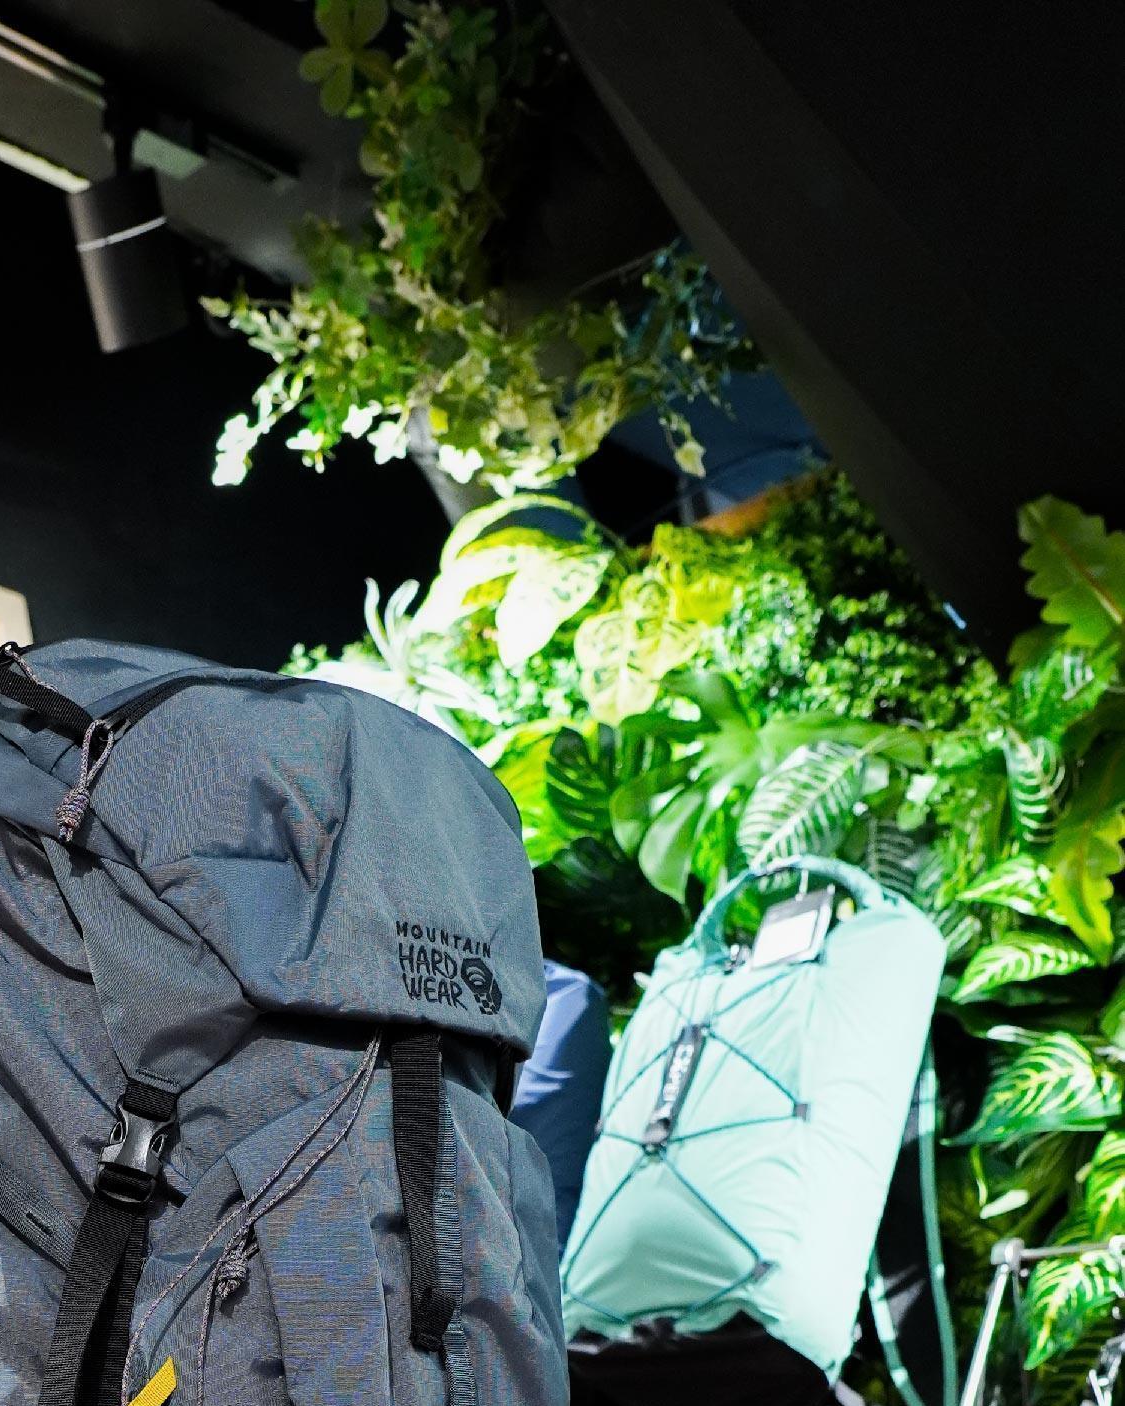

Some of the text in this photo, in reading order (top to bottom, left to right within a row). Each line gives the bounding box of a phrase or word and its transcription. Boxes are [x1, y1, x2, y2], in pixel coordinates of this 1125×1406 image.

[395, 920, 491, 958] MOUNTAIN
[398, 942, 458, 980] HARD
[401, 972, 468, 1012] WEAR
